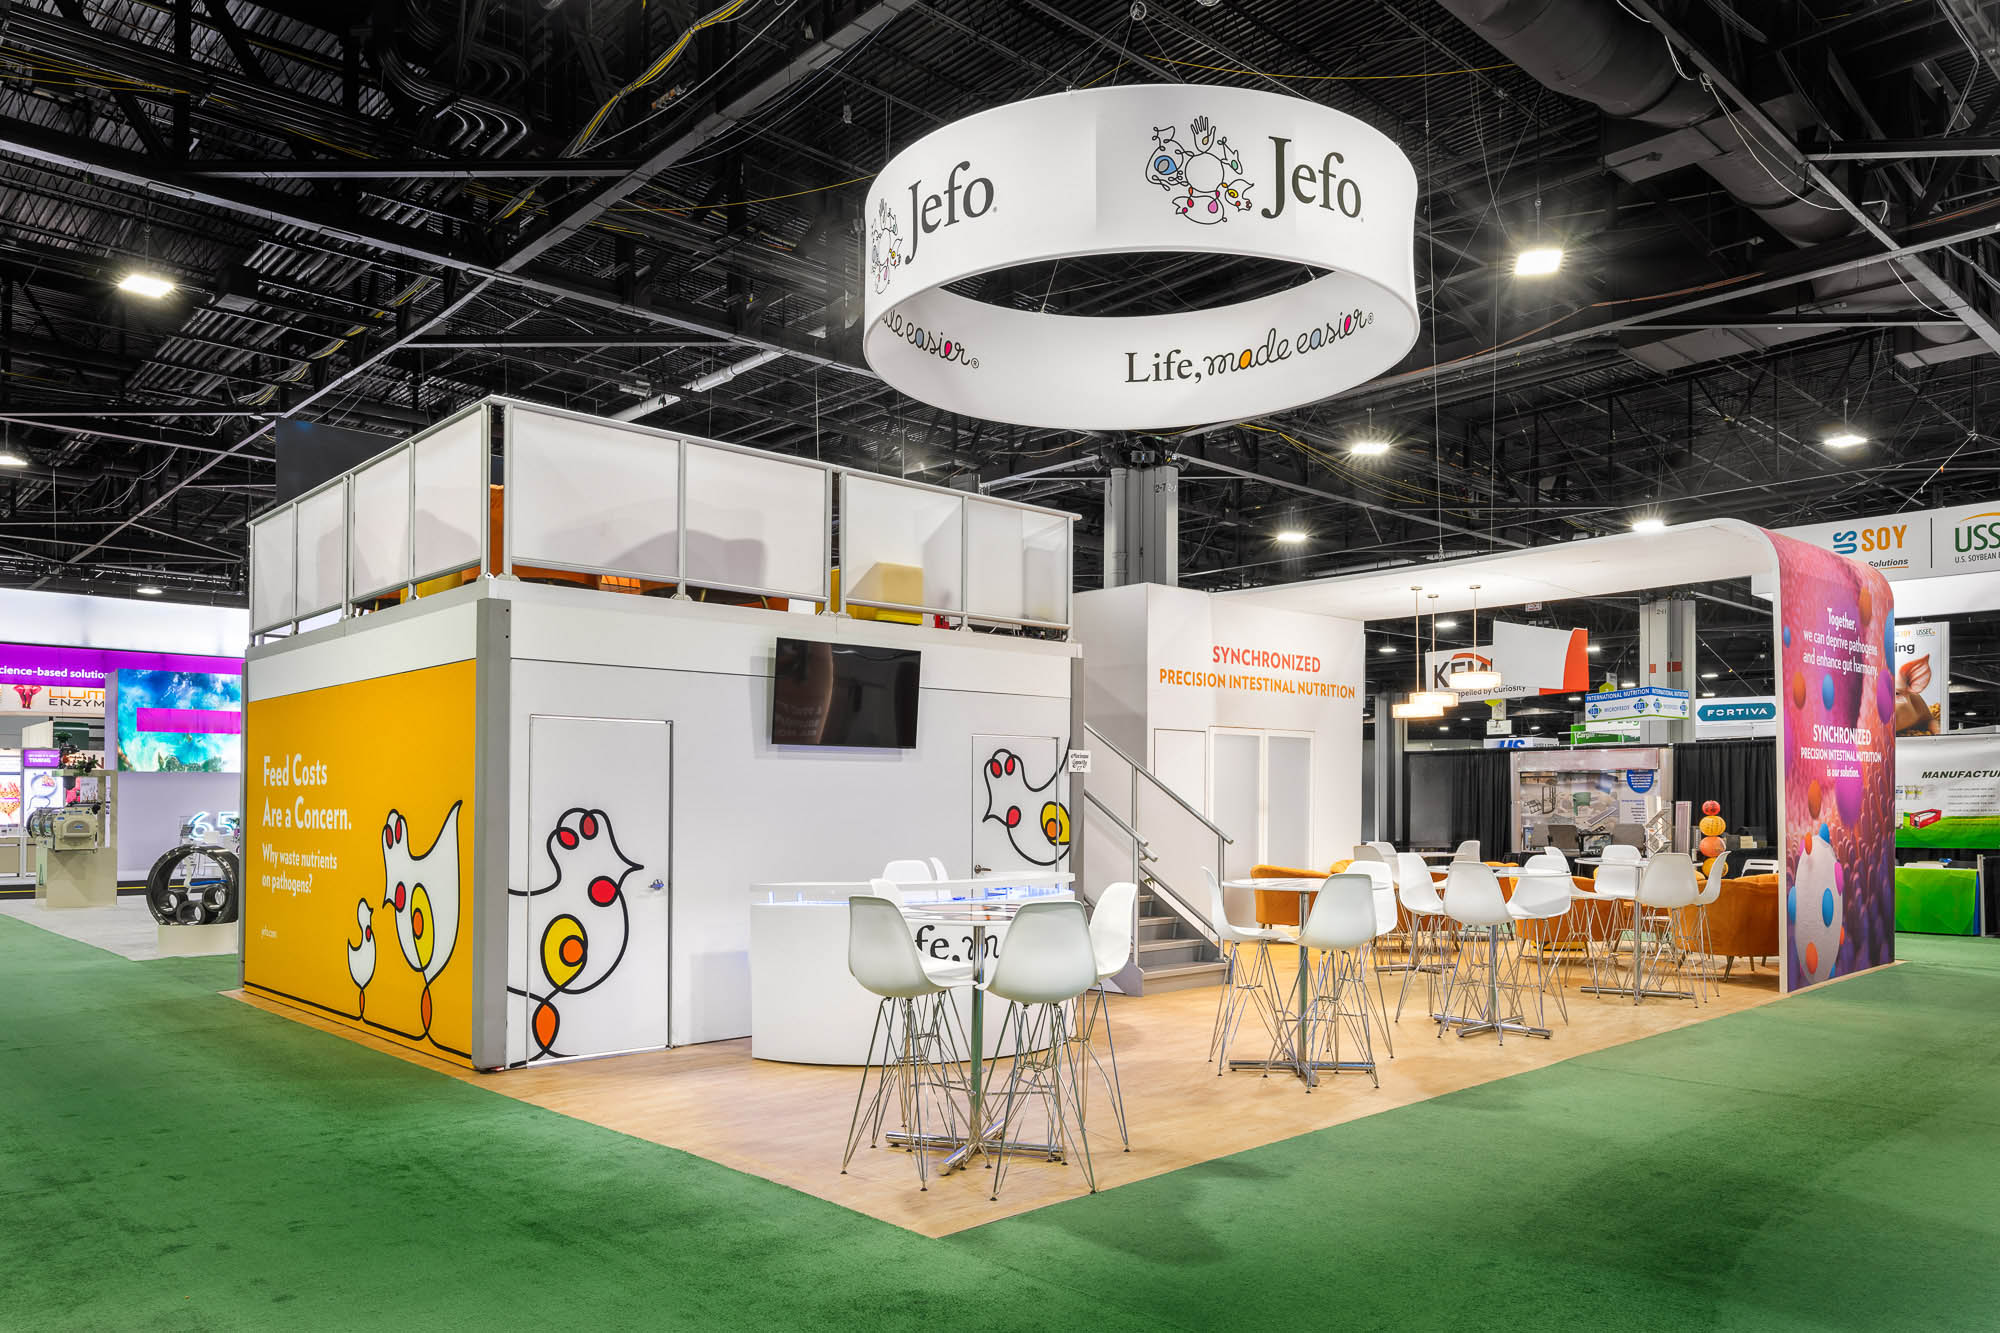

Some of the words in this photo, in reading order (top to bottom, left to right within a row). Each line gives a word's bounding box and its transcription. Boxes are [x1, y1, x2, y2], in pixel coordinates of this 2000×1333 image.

[1261, 136, 1362, 219] Jefo
[904, 160, 996, 265] Jefo
[1124, 349, 1201, 384] Life,
[1203, 328, 1292, 375] made
[1861, 524, 1908, 552] SOY
[1868, 558, 1909, 568] Solutions
[1968, 552, 1997, 562] SOYBEAN
[1827, 607, 1857, 632] Together,
[1803, 630, 1813, 642] we
[1813, 631, 1825, 645] can
[1825, 629, 1849, 652] deprive
[1848, 635, 1878, 659] pathogens
[1895, 642, 1915, 654] ing
[1212, 645, 1321, 673] SYNCHRONIZED
[1802, 647, 1816, 665] and
[1816, 649, 1842, 670] enhance
[1842, 659, 1853, 675] gut
[1159, 668, 1226, 689] PRECISION
[1228, 674, 1296, 694] INTESTINAL
[1297, 682, 1355, 699] NUTRITION
[1587, 692, 1622, 700] INTERNATIONAL
[1623, 687, 1650, 697] NUTRITION
[48, 698, 105, 708] ENZYM
[1707, 707, 1768, 717] FORTIVA
[1813, 724, 1872, 746] SYNCHRONIZED
[1800, 747, 1828, 761] PRECISION
[1828, 749, 1857, 762] INTESTINAL
[263, 754, 289, 787] Feed
[292, 753, 328, 787] Costs
[262, 796, 283, 828] Are
[285, 807, 292, 828] a
[294, 795, 352, 831] Concern.
[262, 843, 277, 870] Why
[279, 852, 300, 867] waste
[301, 849, 338, 870] nutrients
[262, 874, 271, 888] on
[271, 871, 313, 897] pathogens?
